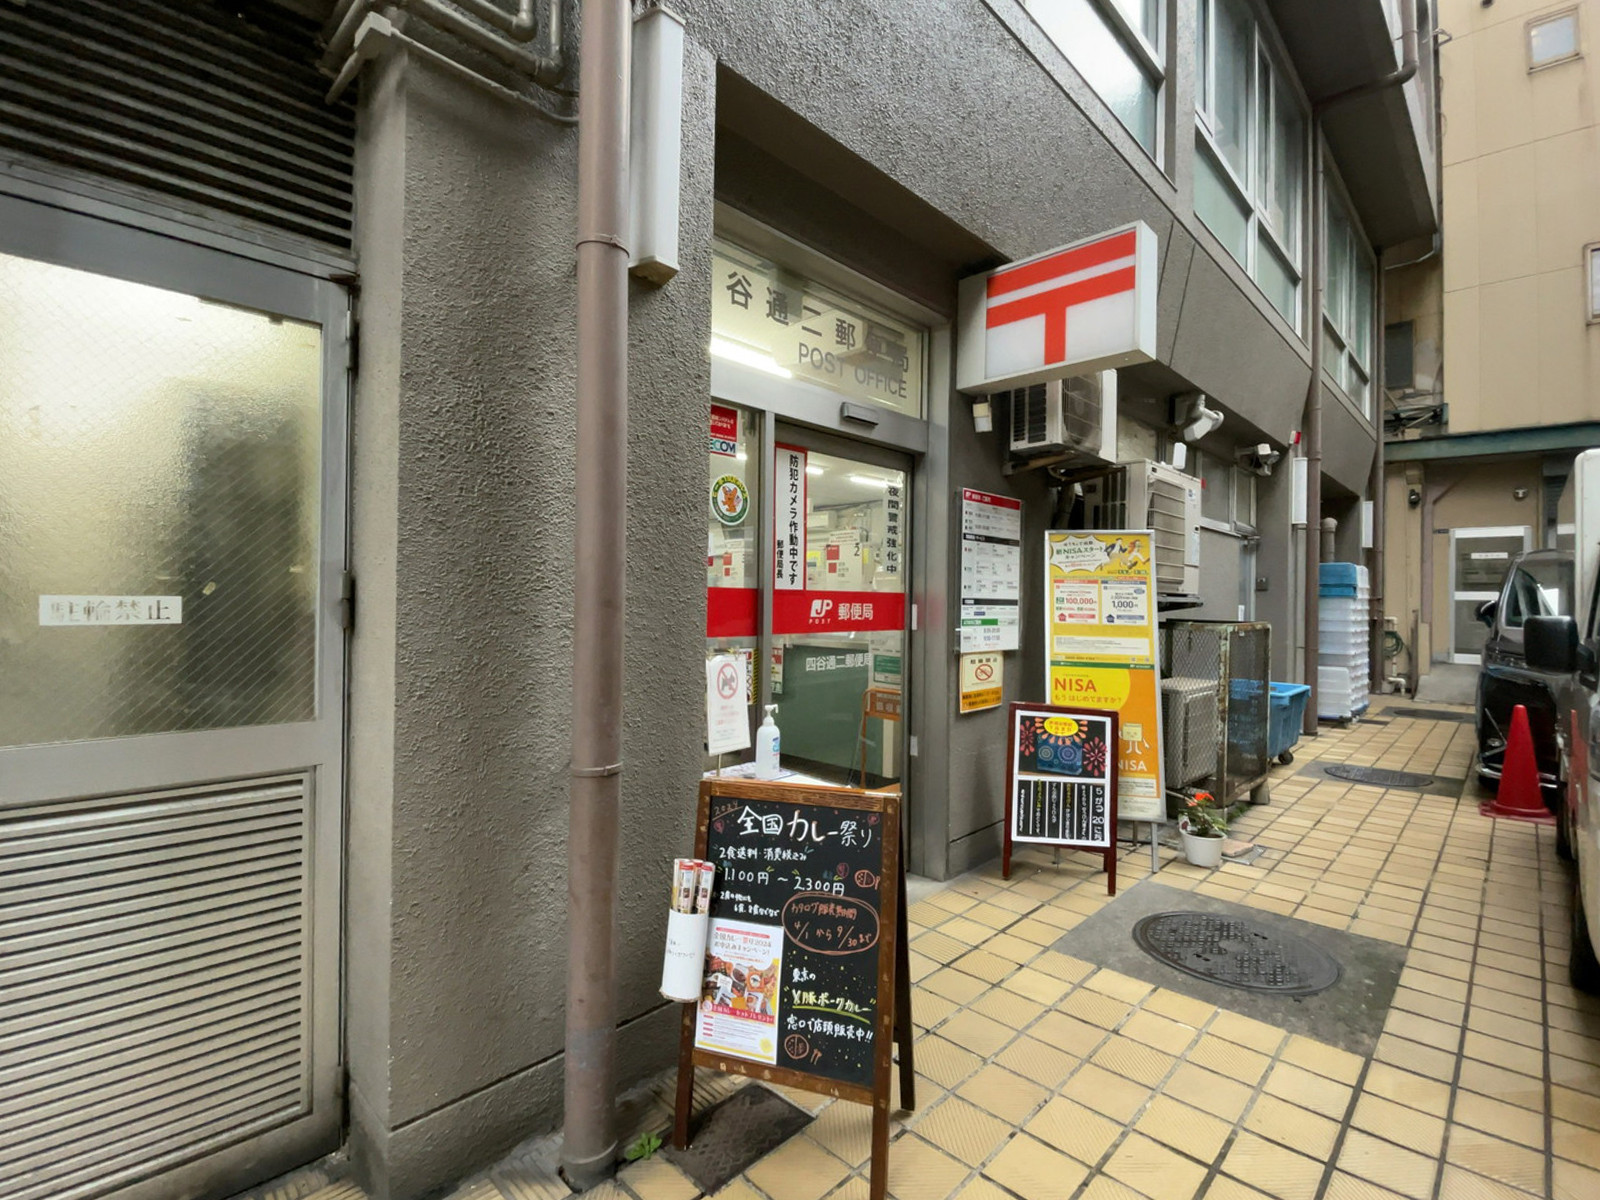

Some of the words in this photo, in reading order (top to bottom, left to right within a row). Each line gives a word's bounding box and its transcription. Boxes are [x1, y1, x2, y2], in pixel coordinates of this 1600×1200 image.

[798, 342, 846, 377] POST
[855, 365, 908, 399] OFFICE
[789, 454, 799, 586] 防犯カメラ作動中です
[886, 486, 900, 574] 夜間警戒強化中
[776, 539, 784, 579] 郵便局長
[810, 599, 833, 618] JP
[838, 603, 873, 621] 郵便局
[805, 653, 873, 672] 四谷通二郵便局
[1054, 678, 1097, 692] NISA
[713, 801, 739, 815] 2024
